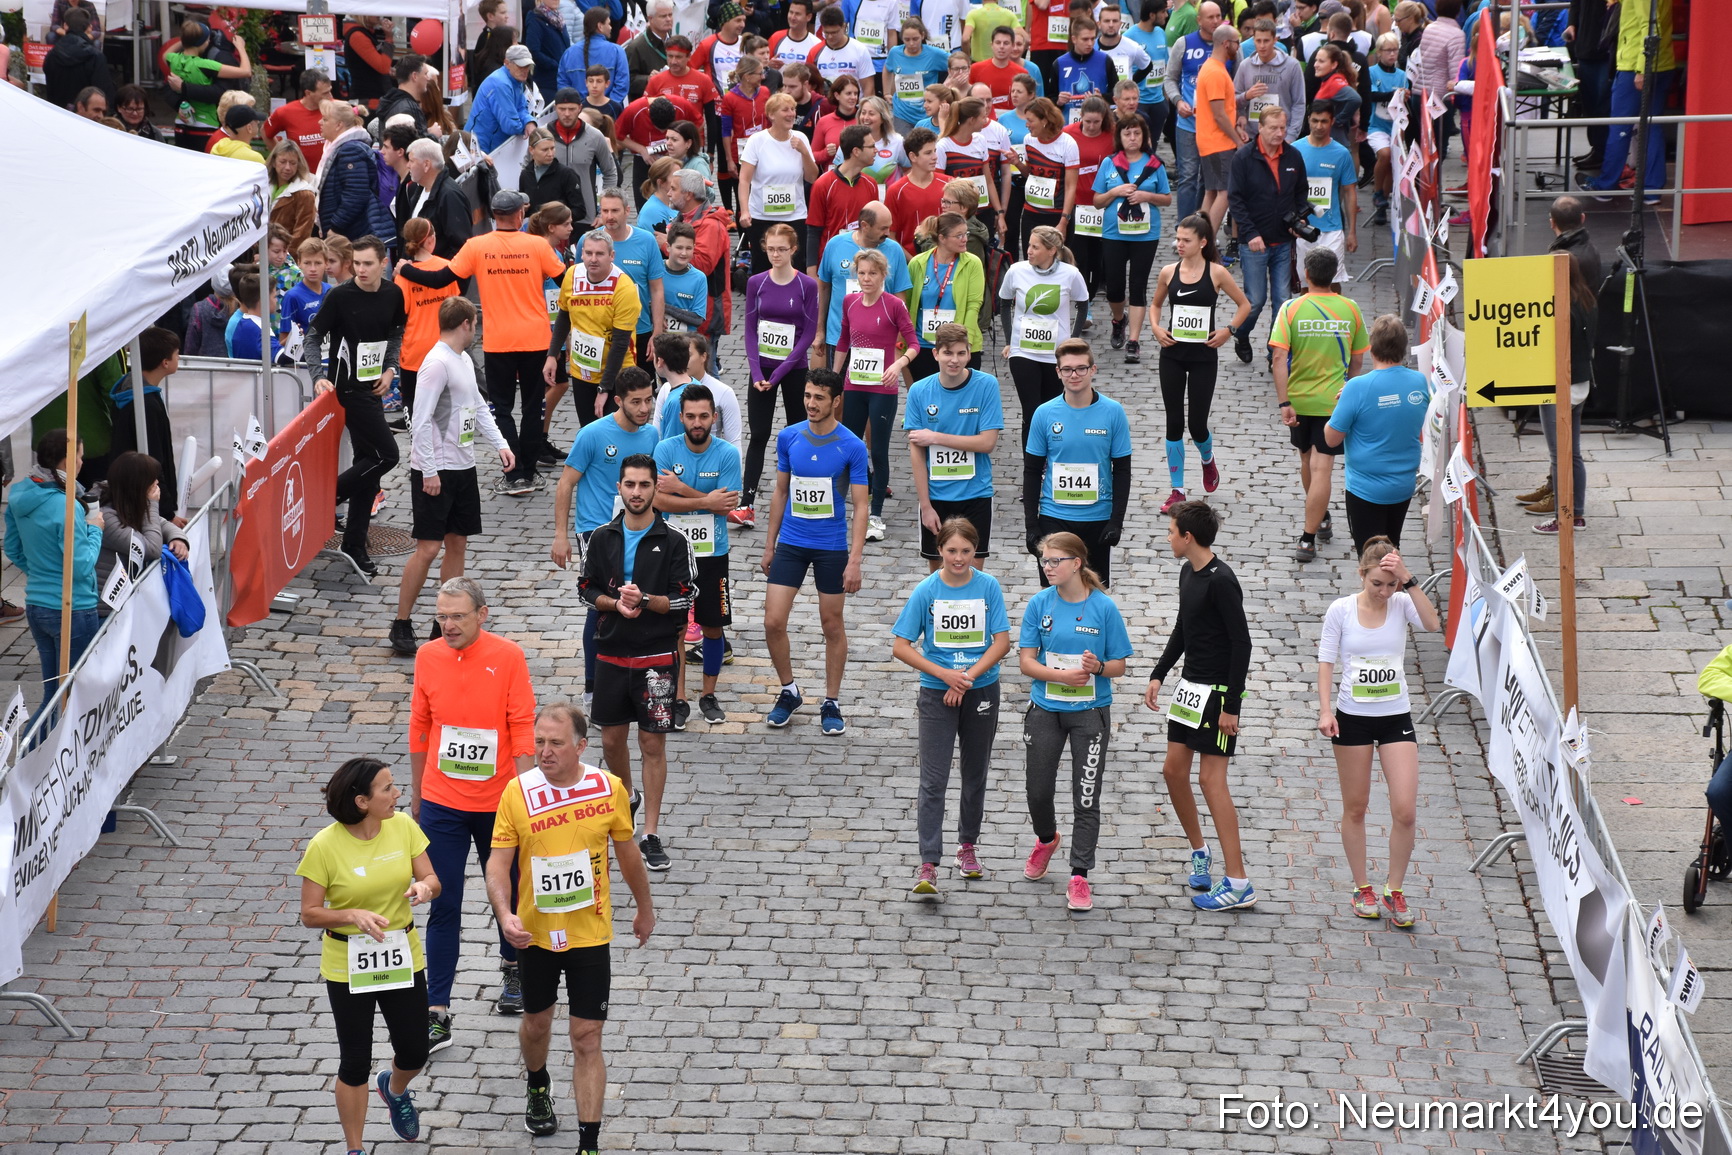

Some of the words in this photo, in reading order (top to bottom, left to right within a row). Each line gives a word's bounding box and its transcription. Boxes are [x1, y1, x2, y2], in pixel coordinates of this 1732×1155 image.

[860, 28, 880, 37] 5108
[1052, 25, 1068, 33] 5154
[1186, 48, 1204, 60] 10
[1063, 66, 1073, 78] 7
[900, 82, 920, 91] 5205
[1028, 185, 1050, 198] 5212
[1309, 186, 1326, 196] 180
[768, 194, 791, 204] 5058
[1080, 214, 1102, 226] 5019
[168, 236, 208, 287] PARTL
[203, 203, 250, 261] Neumarkt
[416, 295, 449, 307] Kettenba
[550, 300, 559, 310] 51
[571, 298, 592, 306] MAX
[1419, 291, 1428, 310] swn
[1468, 296, 1556, 326] Jugend
[1178, 316, 1202, 328] 5001
[1298, 320, 1351, 333] BOCK
[762, 332, 788, 346] 5078
[1025, 328, 1052, 341] 5080
[1496, 324, 1541, 348] lauf
[574, 341, 597, 358] 5126
[362, 353, 380, 366] 5134
[853, 358, 878, 371] 5077
[936, 450, 968, 464] 5124
[1058, 476, 1092, 489] 5144
[796, 489, 826, 503] 5187
[682, 528, 708, 540] 186
[131, 543, 144, 558] sw
[108, 577, 125, 602] swn
[1502, 572, 1524, 594] swn
[941, 614, 976, 630] 5091
[1075, 626, 1100, 634] BOCK
[1358, 668, 1396, 684] 5000
[1176, 688, 1201, 708] 5123
[447, 742, 488, 761] 5137
[454, 764, 479, 772] Manfred
[1080, 743, 1100, 808] adidas
[530, 812, 570, 834] MAX
[574, 804, 614, 821] BÖGL
[541, 869, 585, 892] 5176
[554, 894, 576, 904] Johann
[357, 948, 404, 970] 5115
[1680, 969, 1696, 1004] swn
